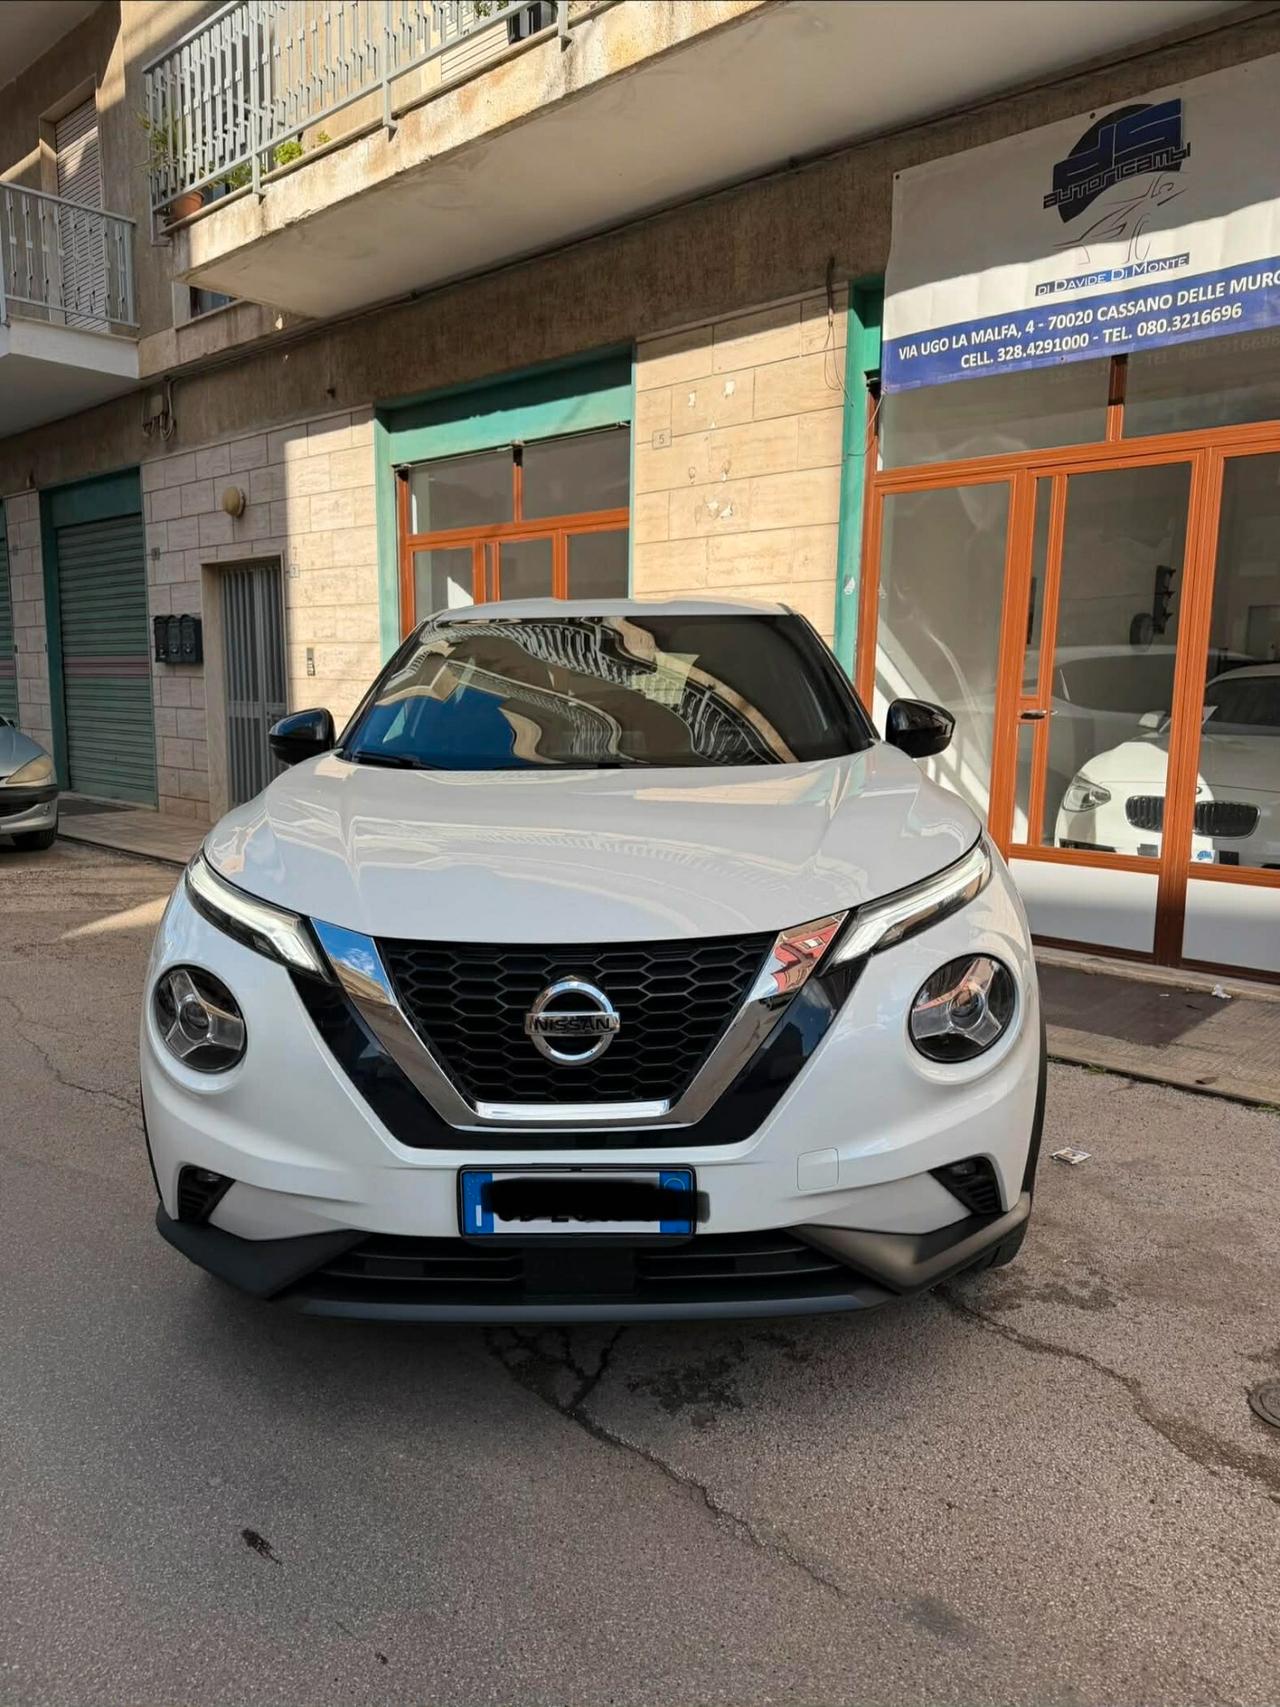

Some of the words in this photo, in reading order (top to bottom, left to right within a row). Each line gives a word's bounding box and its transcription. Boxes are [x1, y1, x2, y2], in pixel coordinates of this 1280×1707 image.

[1054, 273, 1107, 291] DAVIDE
[1132, 256, 1187, 276] MONTE
[898, 345, 918, 360] VIA
[921, 338, 949, 355] UGO
[952, 334, 968, 348] LA
[971, 325, 1021, 345] MALFA,
[1025, 320, 1034, 333] 4
[1048, 309, 1093, 331] 70020
[1097, 294, 1172, 321] CASSANO
[1176, 282, 1225, 306] DELLE
[960, 352, 993, 368] CELL.
[997, 333, 1089, 362] 328.4291000
[1102, 327, 1132, 344] TEL.
[1137, 303, 1242, 337] 080.3216696
[658, 433, 665, 444] 5
[533, 1016, 611, 1032] NISSAN
[475, 1204, 483, 1227] I
